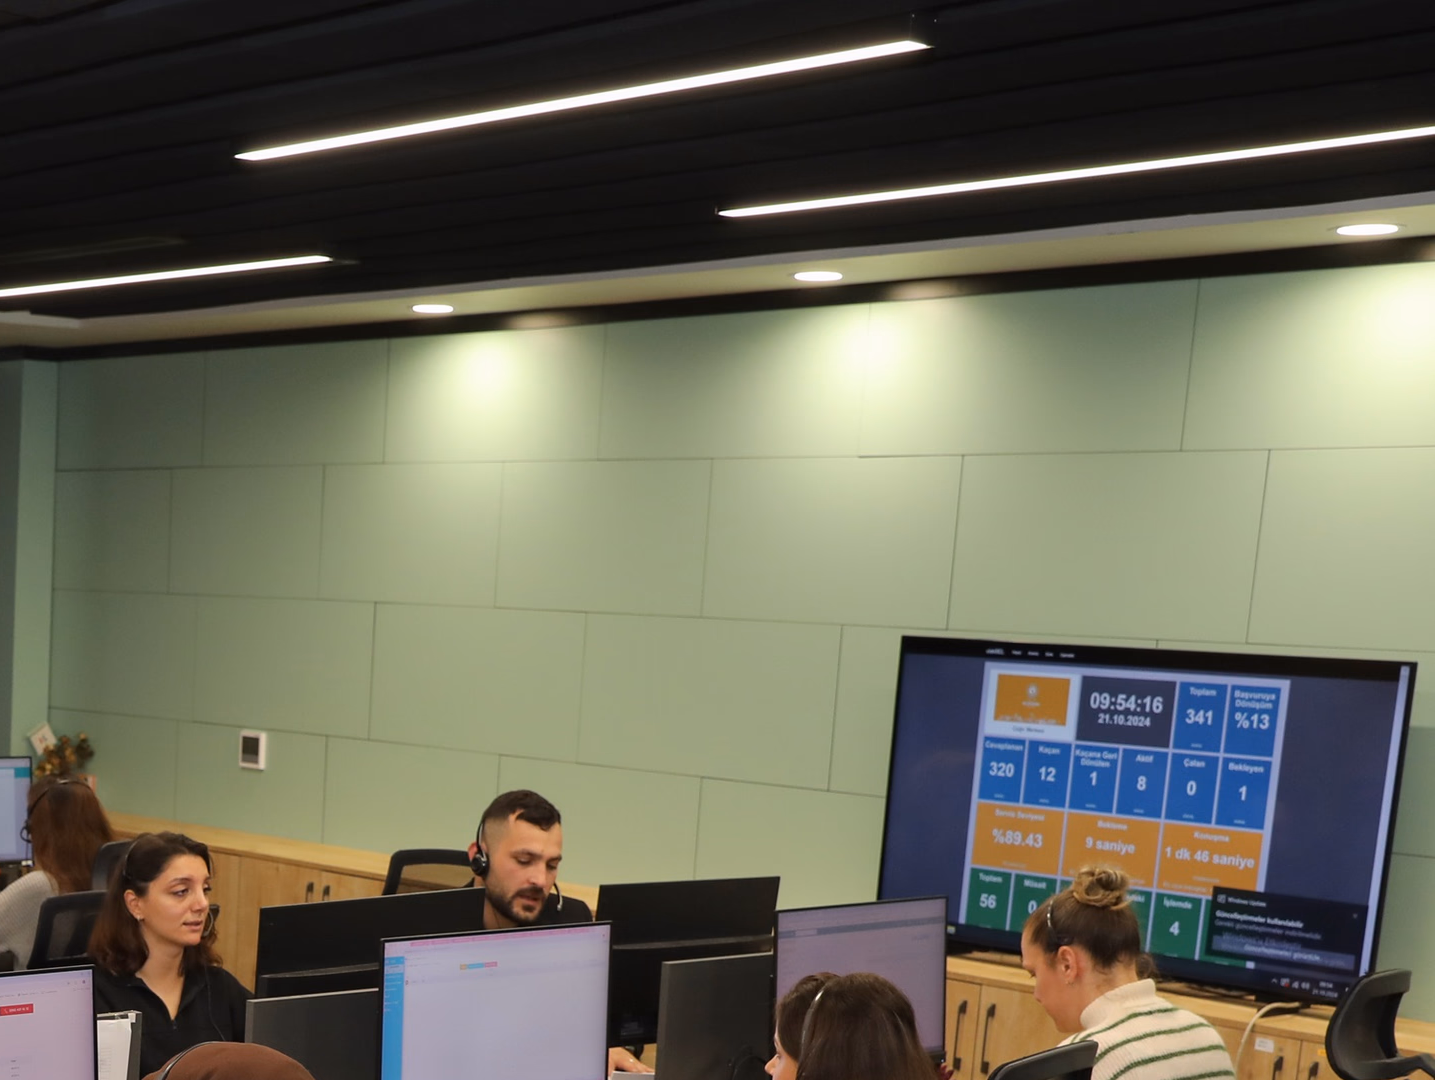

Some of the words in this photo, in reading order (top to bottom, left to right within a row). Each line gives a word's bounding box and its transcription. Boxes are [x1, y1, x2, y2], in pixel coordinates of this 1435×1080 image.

[1189, 687, 1217, 698] Toplam
[1090, 692, 1163, 713] 09:54:16
[1098, 713, 1151, 727] 21.10.2024
[1185, 708, 1214, 726] 341
[1234, 712, 1270, 730] %13
[989, 761, 1015, 778] 320
[1038, 767, 1056, 782] 12
[1228, 762, 1264, 774] Bekleyen
[1089, 771, 1098, 786] 1
[1136, 775, 1147, 791] 8
[1186, 781, 1197, 796] 0
[1238, 785, 1248, 801] 1
[992, 828, 1043, 849] %89.43
[1085, 837, 1093, 849] 9
[1096, 839, 1136, 855] saniye
[1165, 846, 1171, 858] 1
[1175, 848, 1191, 861] dk
[1194, 849, 1209, 863] 46
[1212, 852, 1256, 870] saniye
[978, 872, 1003, 883] Toplam
[979, 893, 997, 909] 56
[1169, 921, 1180, 937] 4
